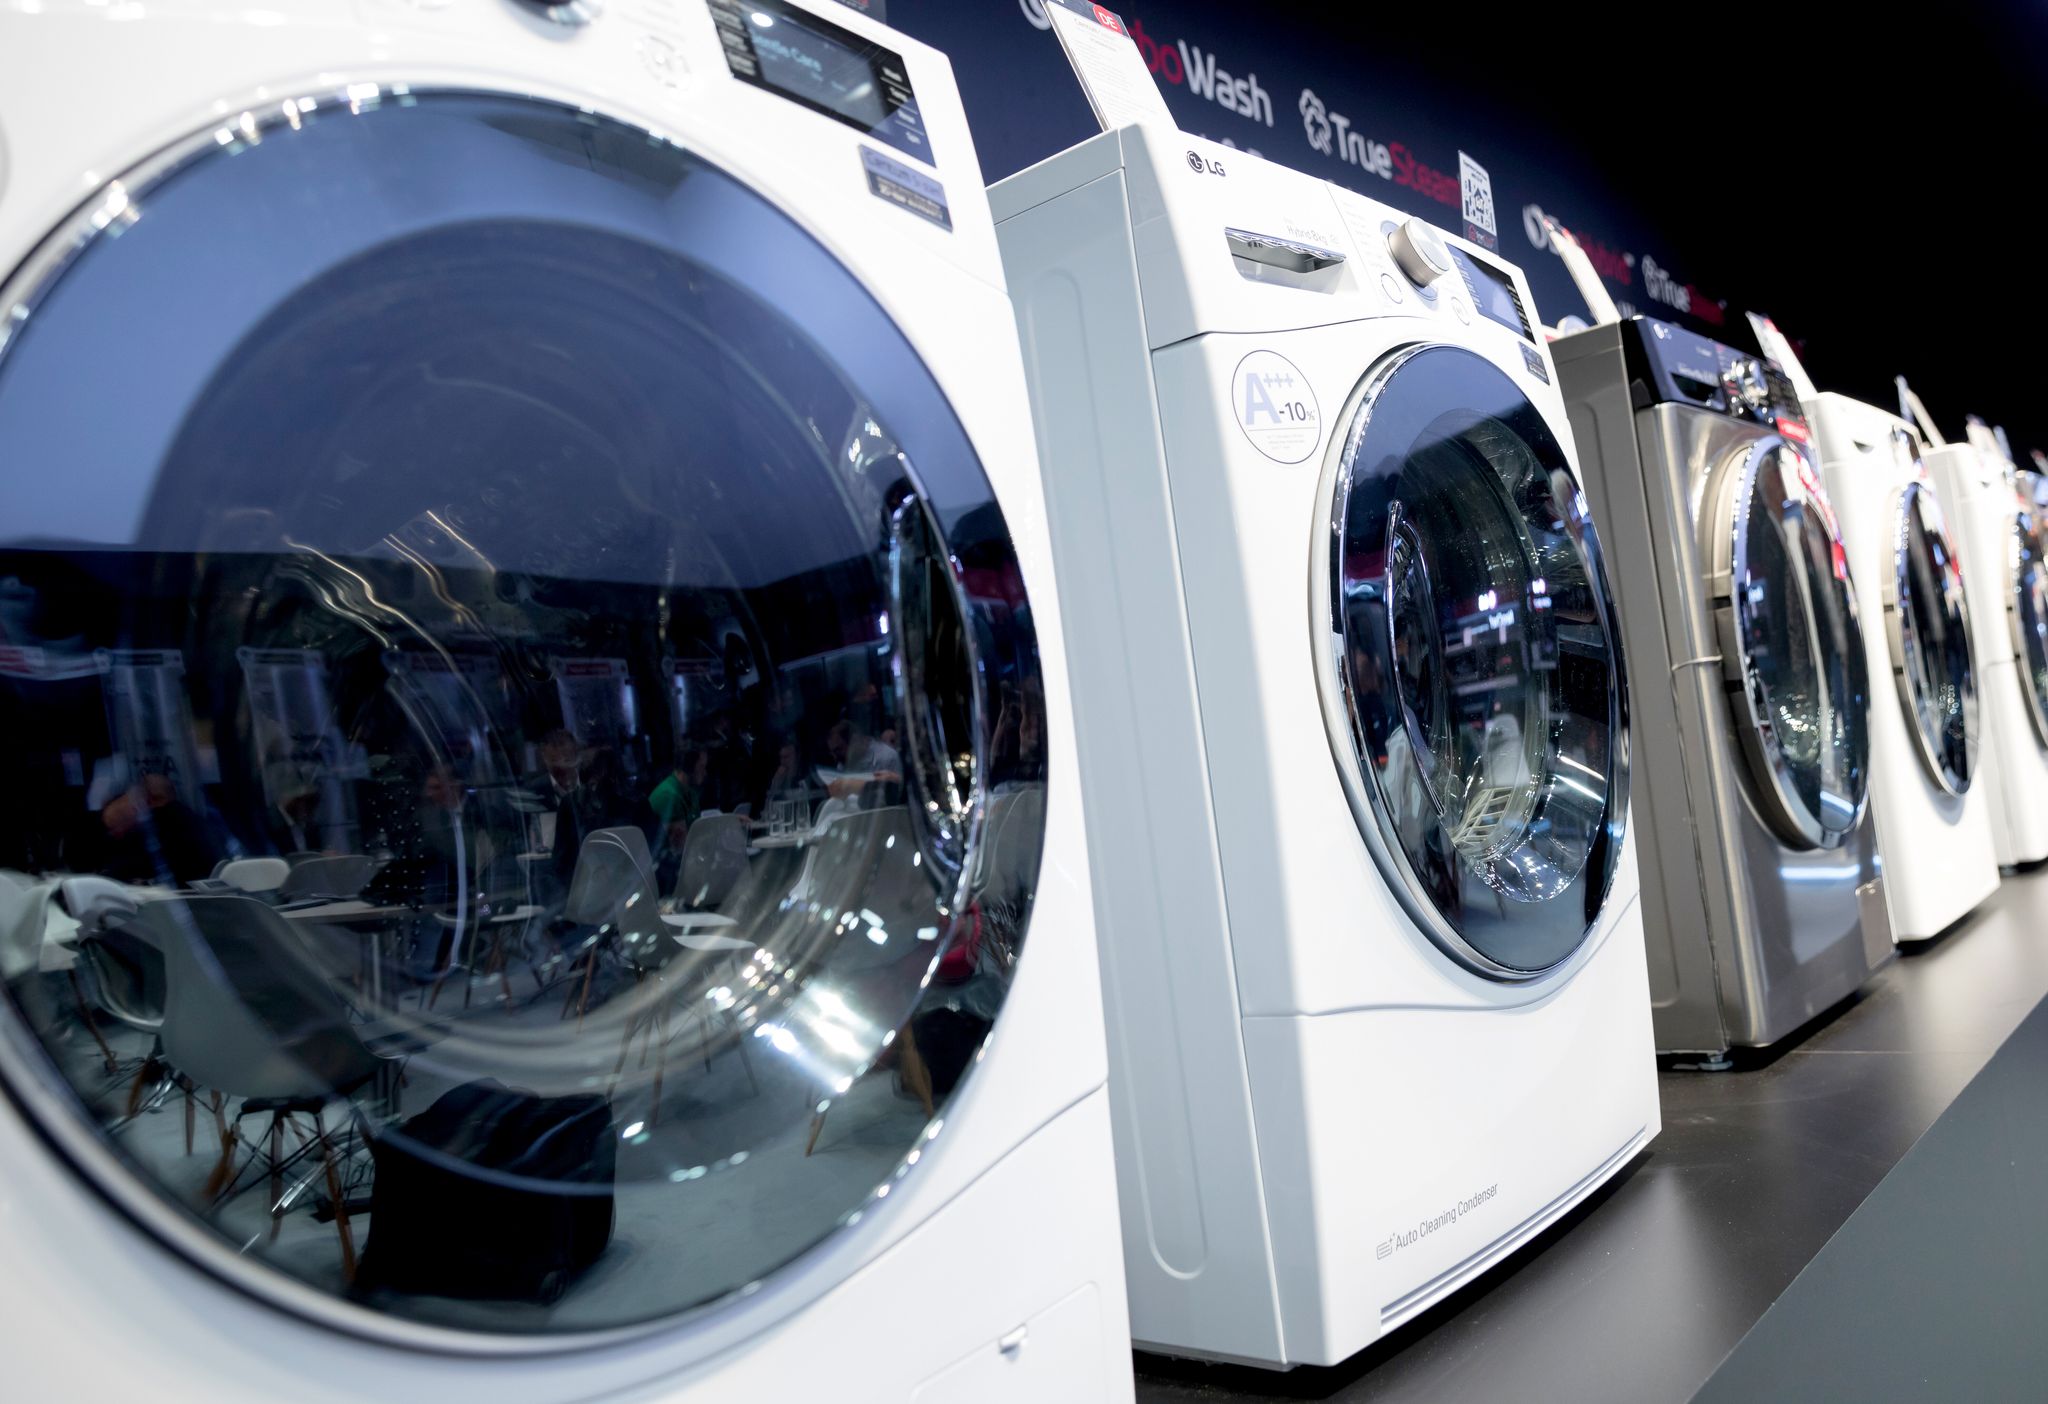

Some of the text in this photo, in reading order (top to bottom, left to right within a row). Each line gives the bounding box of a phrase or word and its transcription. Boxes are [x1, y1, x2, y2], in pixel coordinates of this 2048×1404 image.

[1098, 11, 1118, 29] DE
[1128, 19, 1275, 128] boWash
[1204, 158, 1226, 177] LG
[1395, 1183, 1498, 1251] Auto Cleaning Condenser
